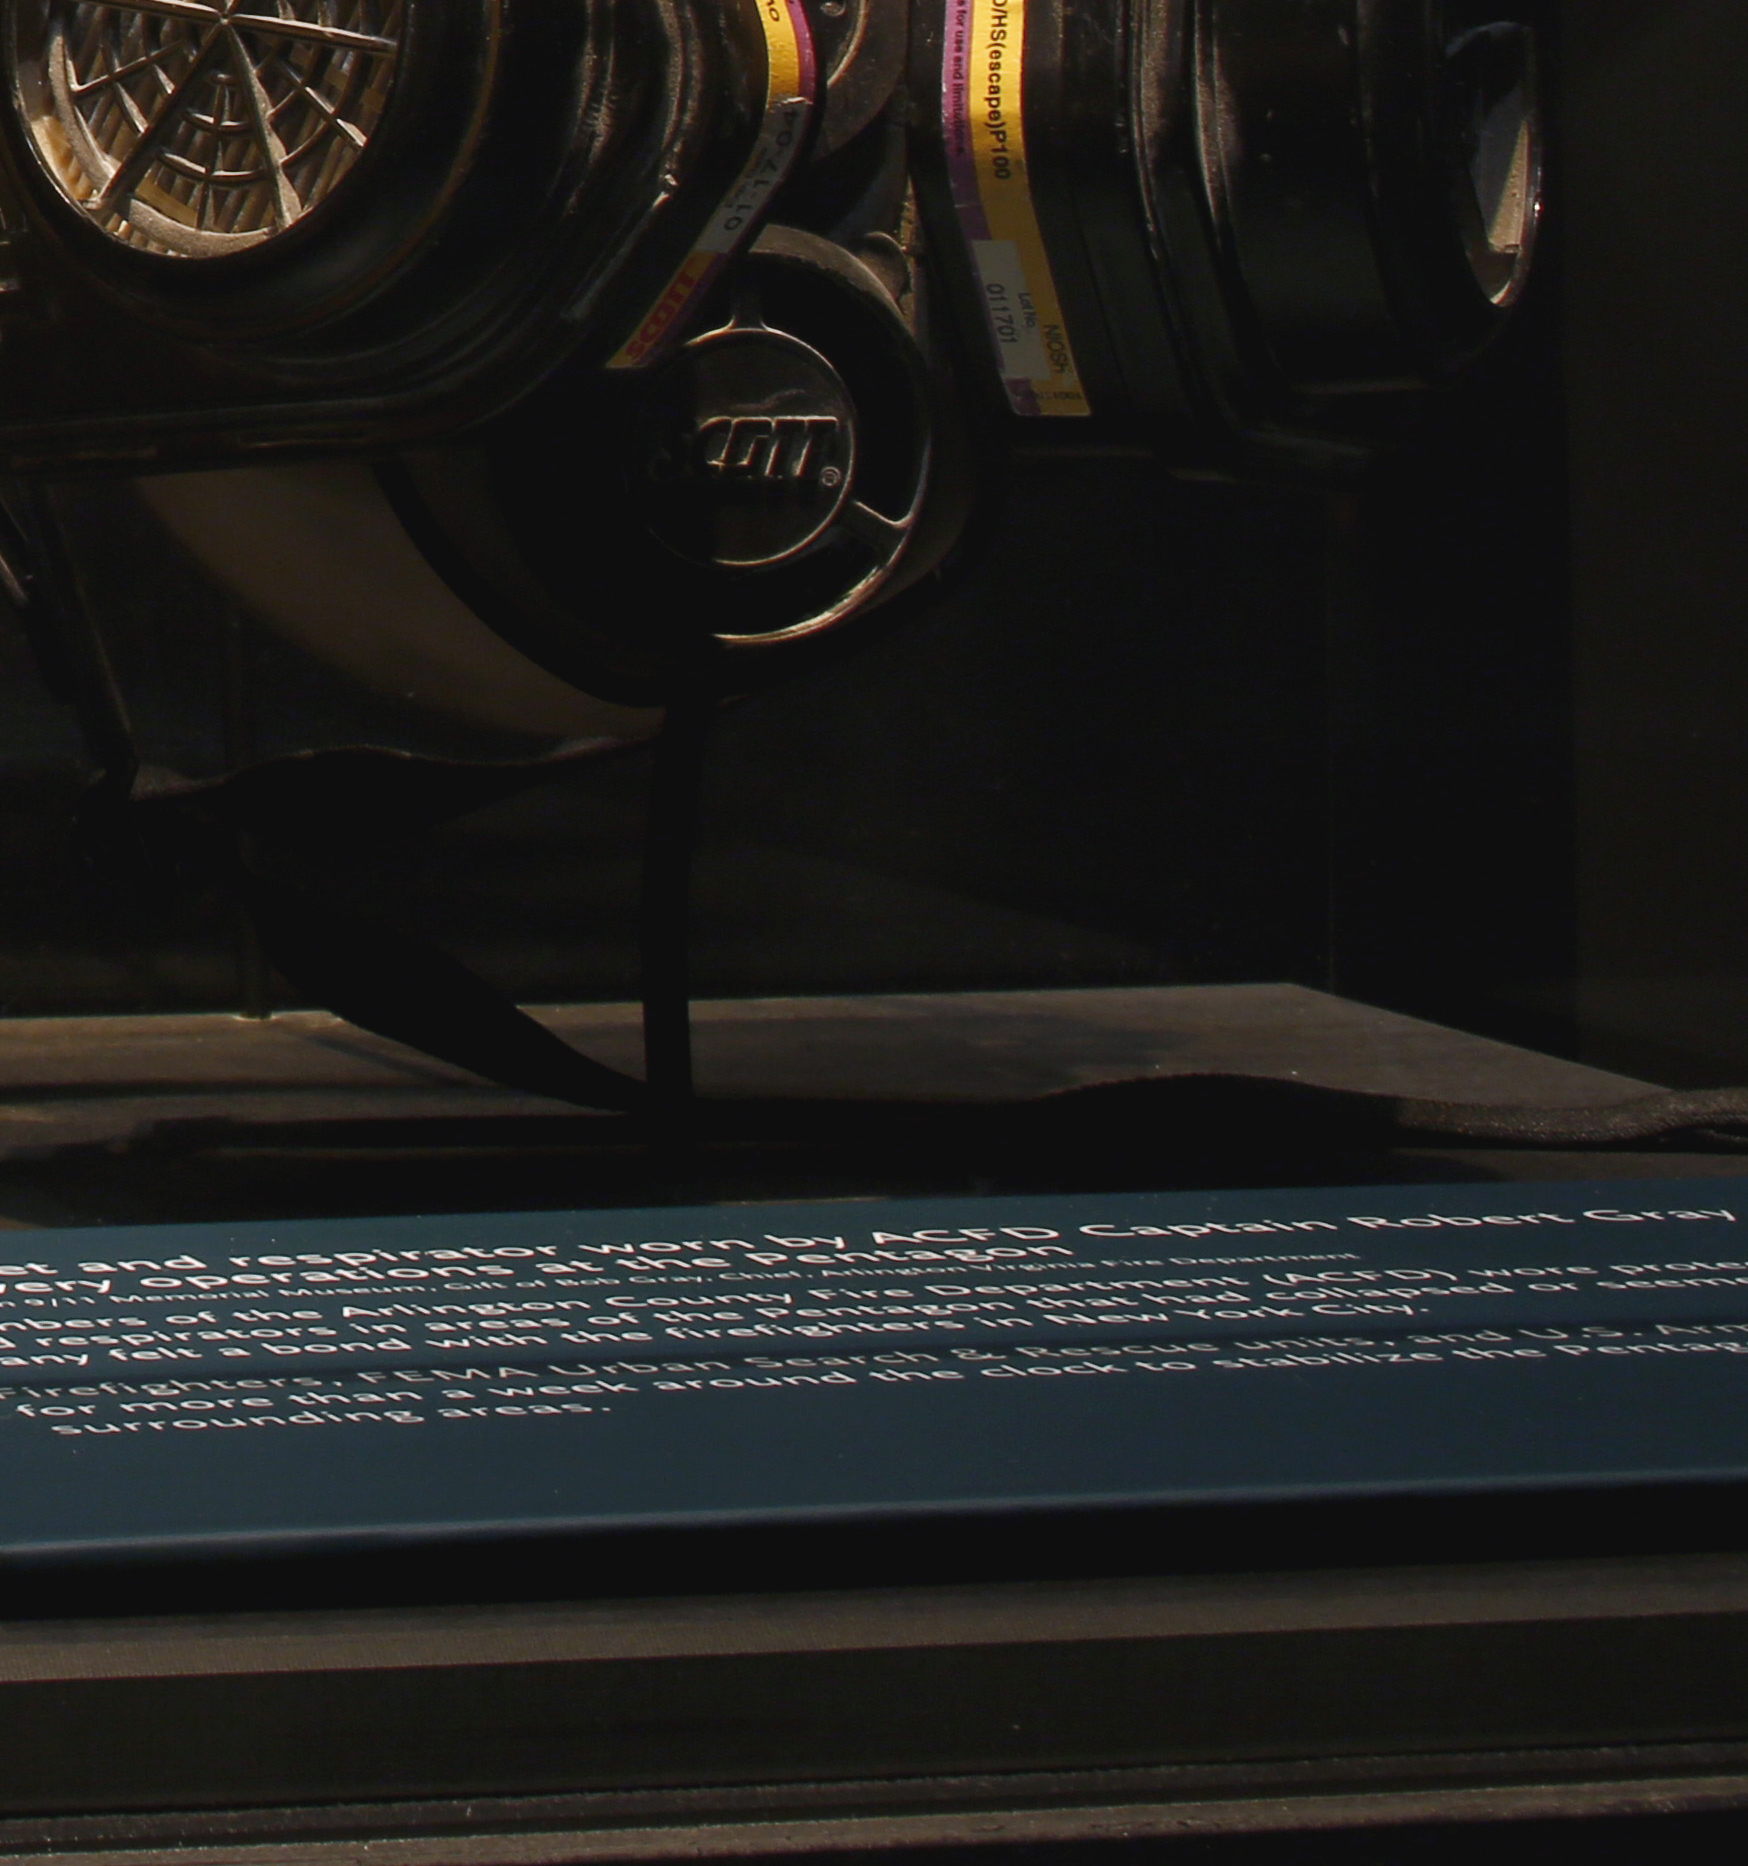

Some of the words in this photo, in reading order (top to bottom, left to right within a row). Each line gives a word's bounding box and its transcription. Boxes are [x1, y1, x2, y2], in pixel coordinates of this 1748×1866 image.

[724, 110, 797, 231] 01-17-04
[624, 267, 696, 359] SCOTT
[986, 283, 1018, 343] 011701
[78, 1254, 207, 1273] and
[229, 1245, 557, 1268] respirator
[578, 1238, 755, 1255] worn
[763, 1234, 847, 1250] by
[871, 1225, 1061, 1246] ACFD
[1078, 1219, 1338, 1238] Captain
[1346, 1211, 1576, 1230] Robert
[1583, 1208, 1737, 1223] Gray
[140, 1265, 515, 1290] operations
[536, 1259, 604, 1274] at
[615, 1255, 732, 1271] the
[744, 1244, 1074, 1266] Pentagon
[35, 1325, 337, 1348] respirators
[349, 1321, 407, 1335] in
[424, 1317, 571, 1333] areas
[587, 1311, 641, 1326] of
[653, 1309, 745, 1324] the
[754, 1300, 1016, 1320] Pentagon
[1026, 1296, 1139, 1310] that
[1140, 1290, 1252, 1306] had
[1266, 1281, 1515, 1301] collapsed
[1527, 1282, 1580, 1292] or
[108, 1289, 270, 1304] Memorial
[165, 1310, 217, 1325] of
[232, 1309, 323, 1323] the
[342, 1298, 591, 1319] Arlington
[604, 1292, 794, 1308] County
[808, 1288, 915, 1301] Fire
[924, 1275, 1251, 1297] Department
[1262, 1268, 1459, 1286] (ACFD)
[1467, 1266, 1599, 1278] wore
[1609, 1261, 1748, 1276] prote
[108, 1346, 203, 1362] felt
[218, 1346, 251, 1358] a
[260, 1338, 413, 1356] bond
[425, 1332, 549, 1350] with
[560, 1330, 654, 1345] the
[664, 1318, 967, 1340] firefighters
[973, 1316, 1034, 1329] in
[1043, 1311, 1171, 1326] New
[1171, 1305, 1305, 1321] York
[1311, 1303, 1431, 1316] City.
[356, 1365, 539, 1385] FEMA
[548, 1359, 732, 1377] Urban
[743, 1351, 940, 1368] Search
[950, 1348, 1007, 1361] &
[1015, 1342, 1221, 1359] Rescue
[1233, 1337, 1396, 1351] units,
[1407, 1329, 1513, 1345] and
[1518, 1326, 1643, 1340] U.S.
[15, 1403, 97, 1417] for
[119, 1397, 274, 1414] more
[288, 1390, 424, 1405] than
[441, 1389, 476, 1400] a
[487, 1380, 640, 1399] week
[653, 1371, 858, 1391] around
[869, 1369, 965, 1382] the
[980, 1361, 1129, 1378] clock
[1134, 1360, 1198, 1371] to
[1212, 1352, 1443, 1369] stabilize
[1452, 1347, 1547, 1360] the
[51, 1409, 425, 1435] surrounding
[437, 1403, 611, 1419] areas.
